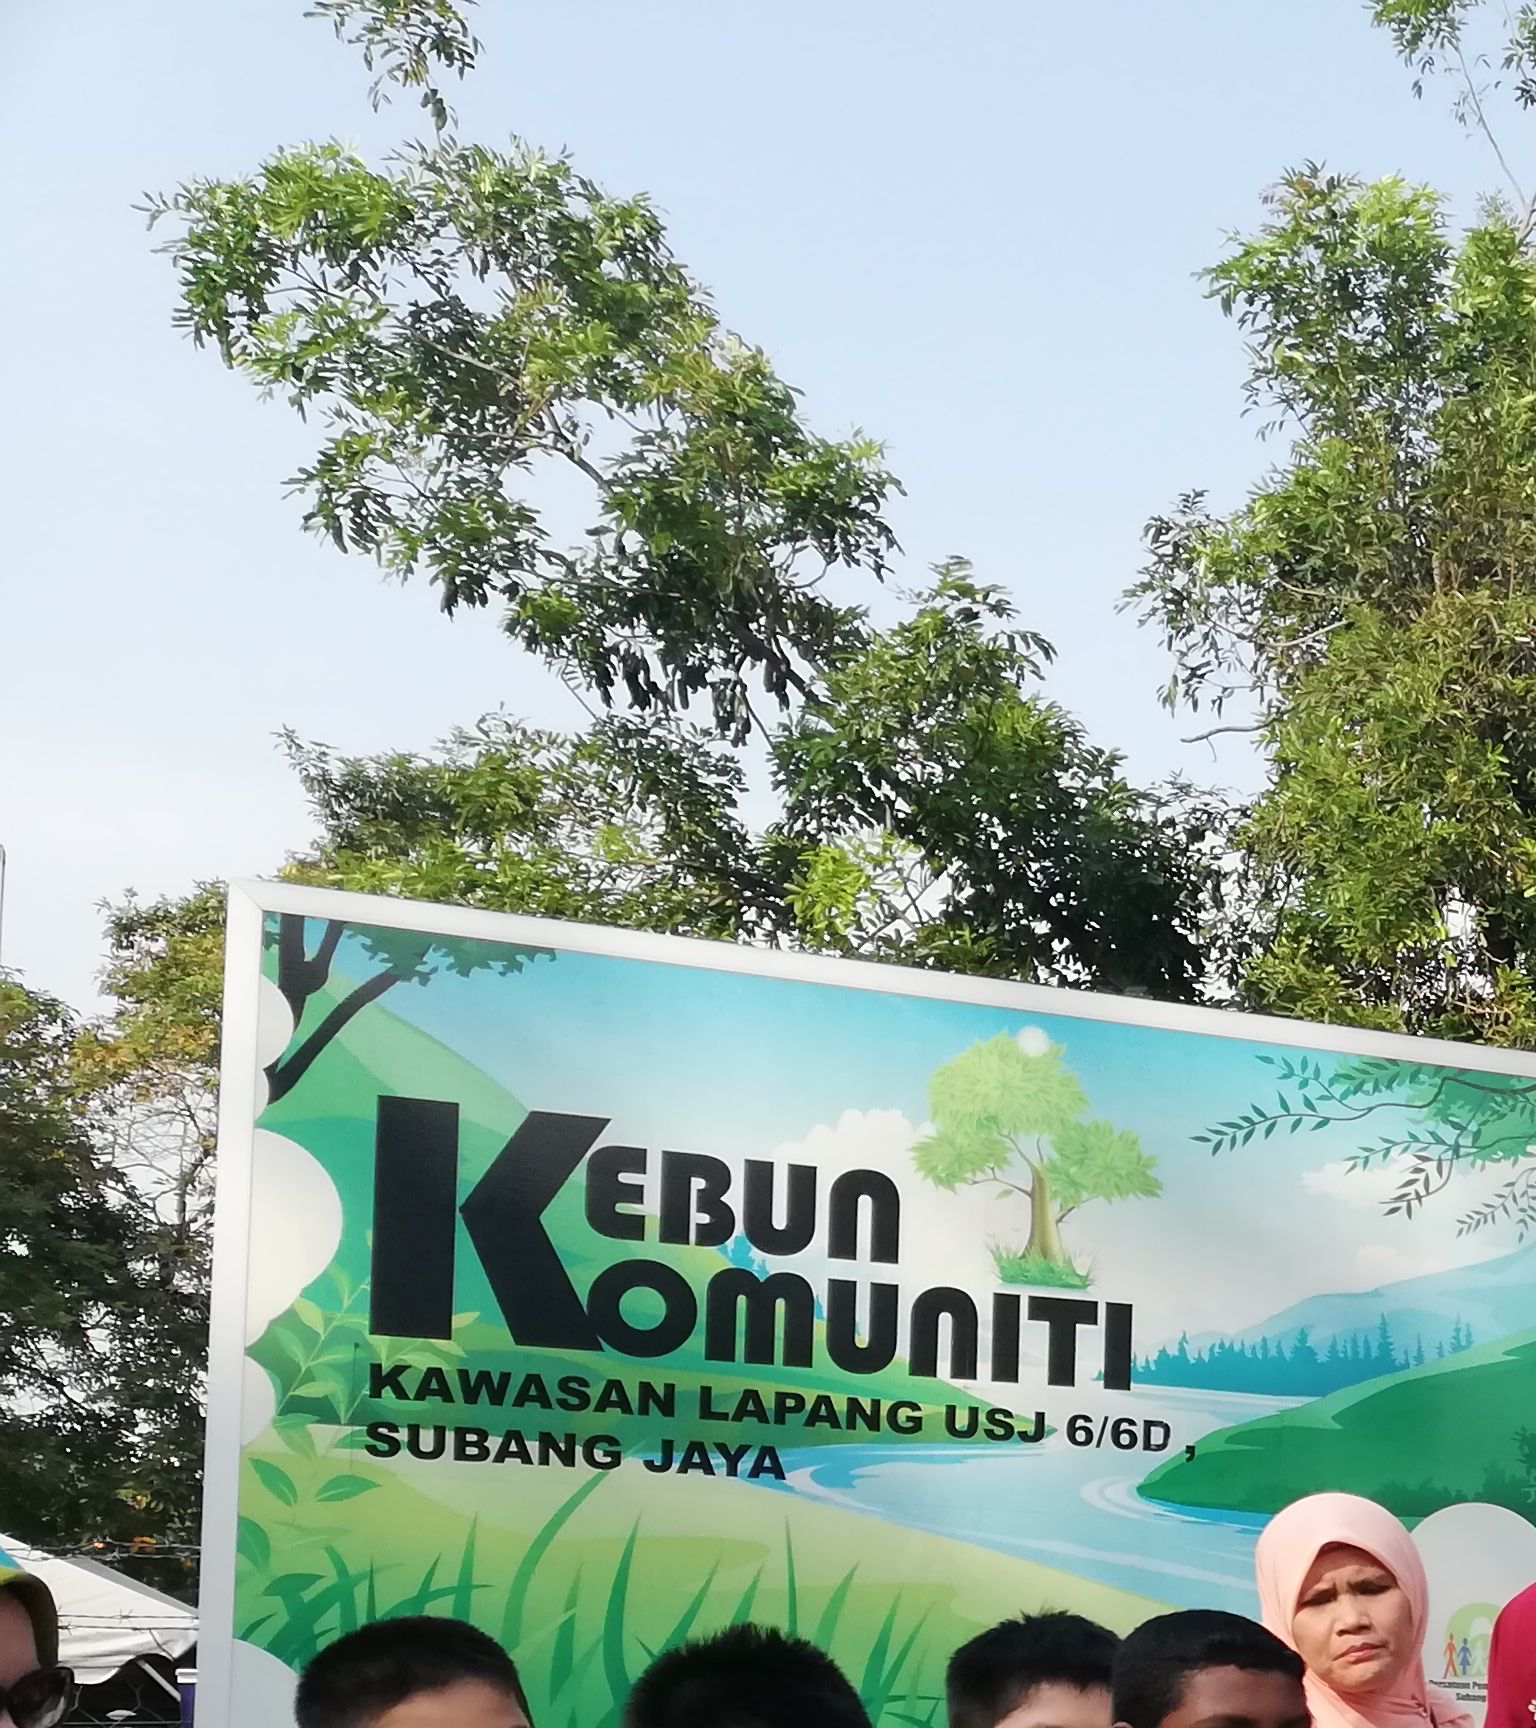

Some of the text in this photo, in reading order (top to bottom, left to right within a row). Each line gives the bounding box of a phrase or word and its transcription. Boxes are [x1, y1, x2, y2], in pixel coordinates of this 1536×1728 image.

[368, 1362, 676, 1417] KAWASAN
[699, 1385, 923, 1435] LAPANG
[945, 1404, 1045, 1443] USJ
[364, 1420, 786, 1481] SUBANG JAYA
